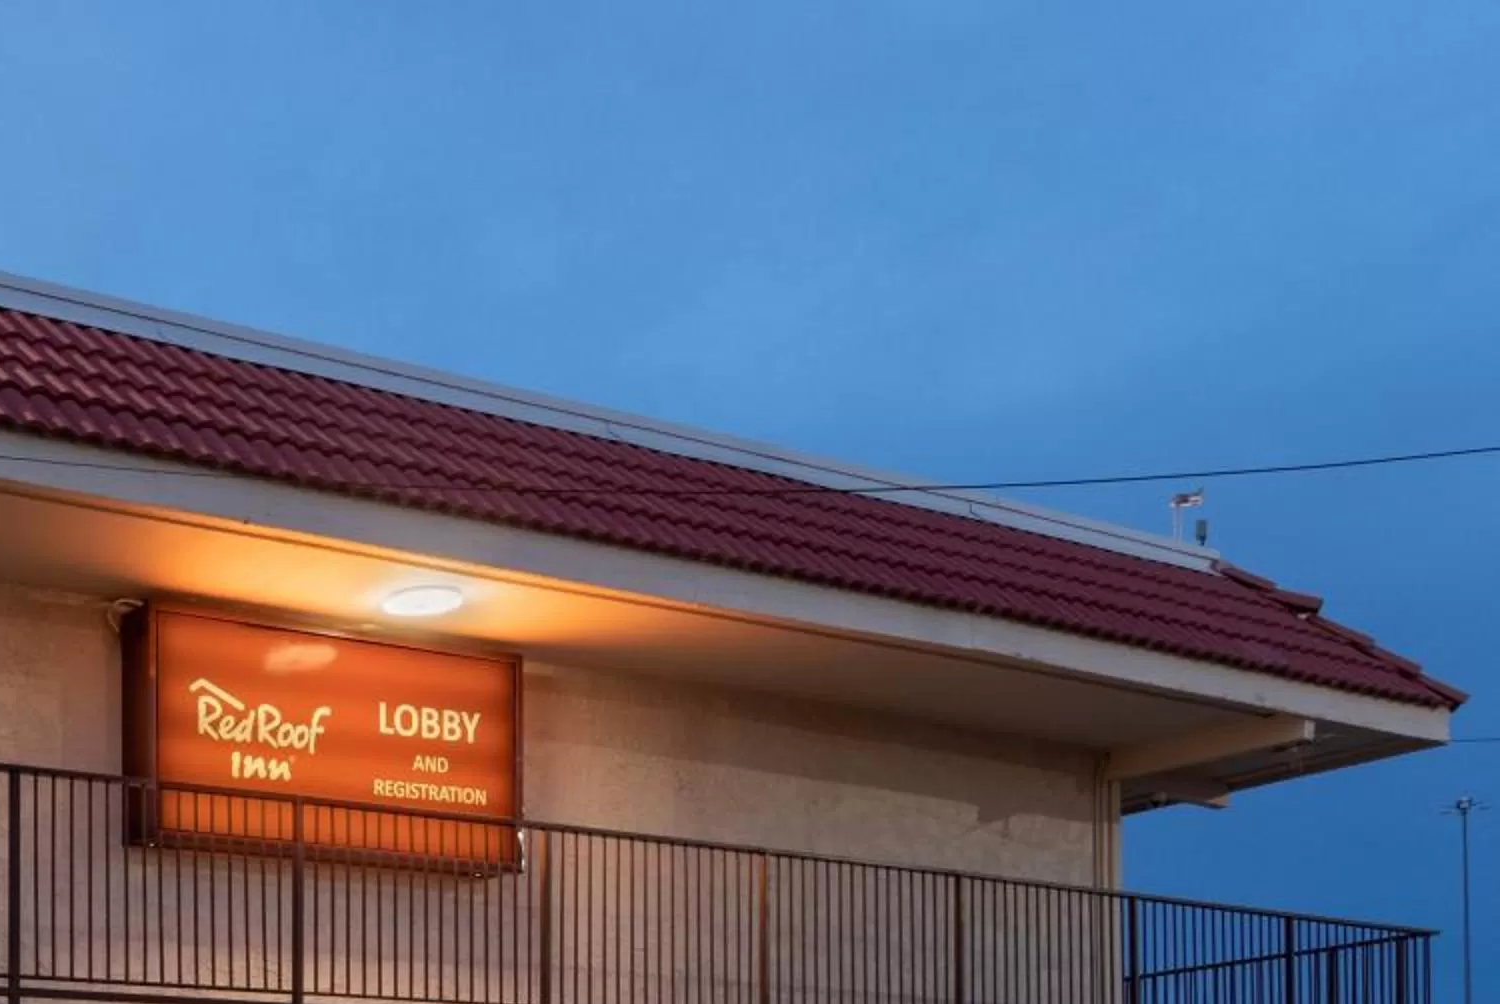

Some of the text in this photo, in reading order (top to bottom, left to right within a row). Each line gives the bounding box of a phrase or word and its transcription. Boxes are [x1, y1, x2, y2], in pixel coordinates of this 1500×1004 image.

[379, 700, 481, 744] LOBBY
[231, 751, 292, 781] Inn
[411, 754, 449, 773] AND
[373, 778, 487, 806] REGISTRATION
